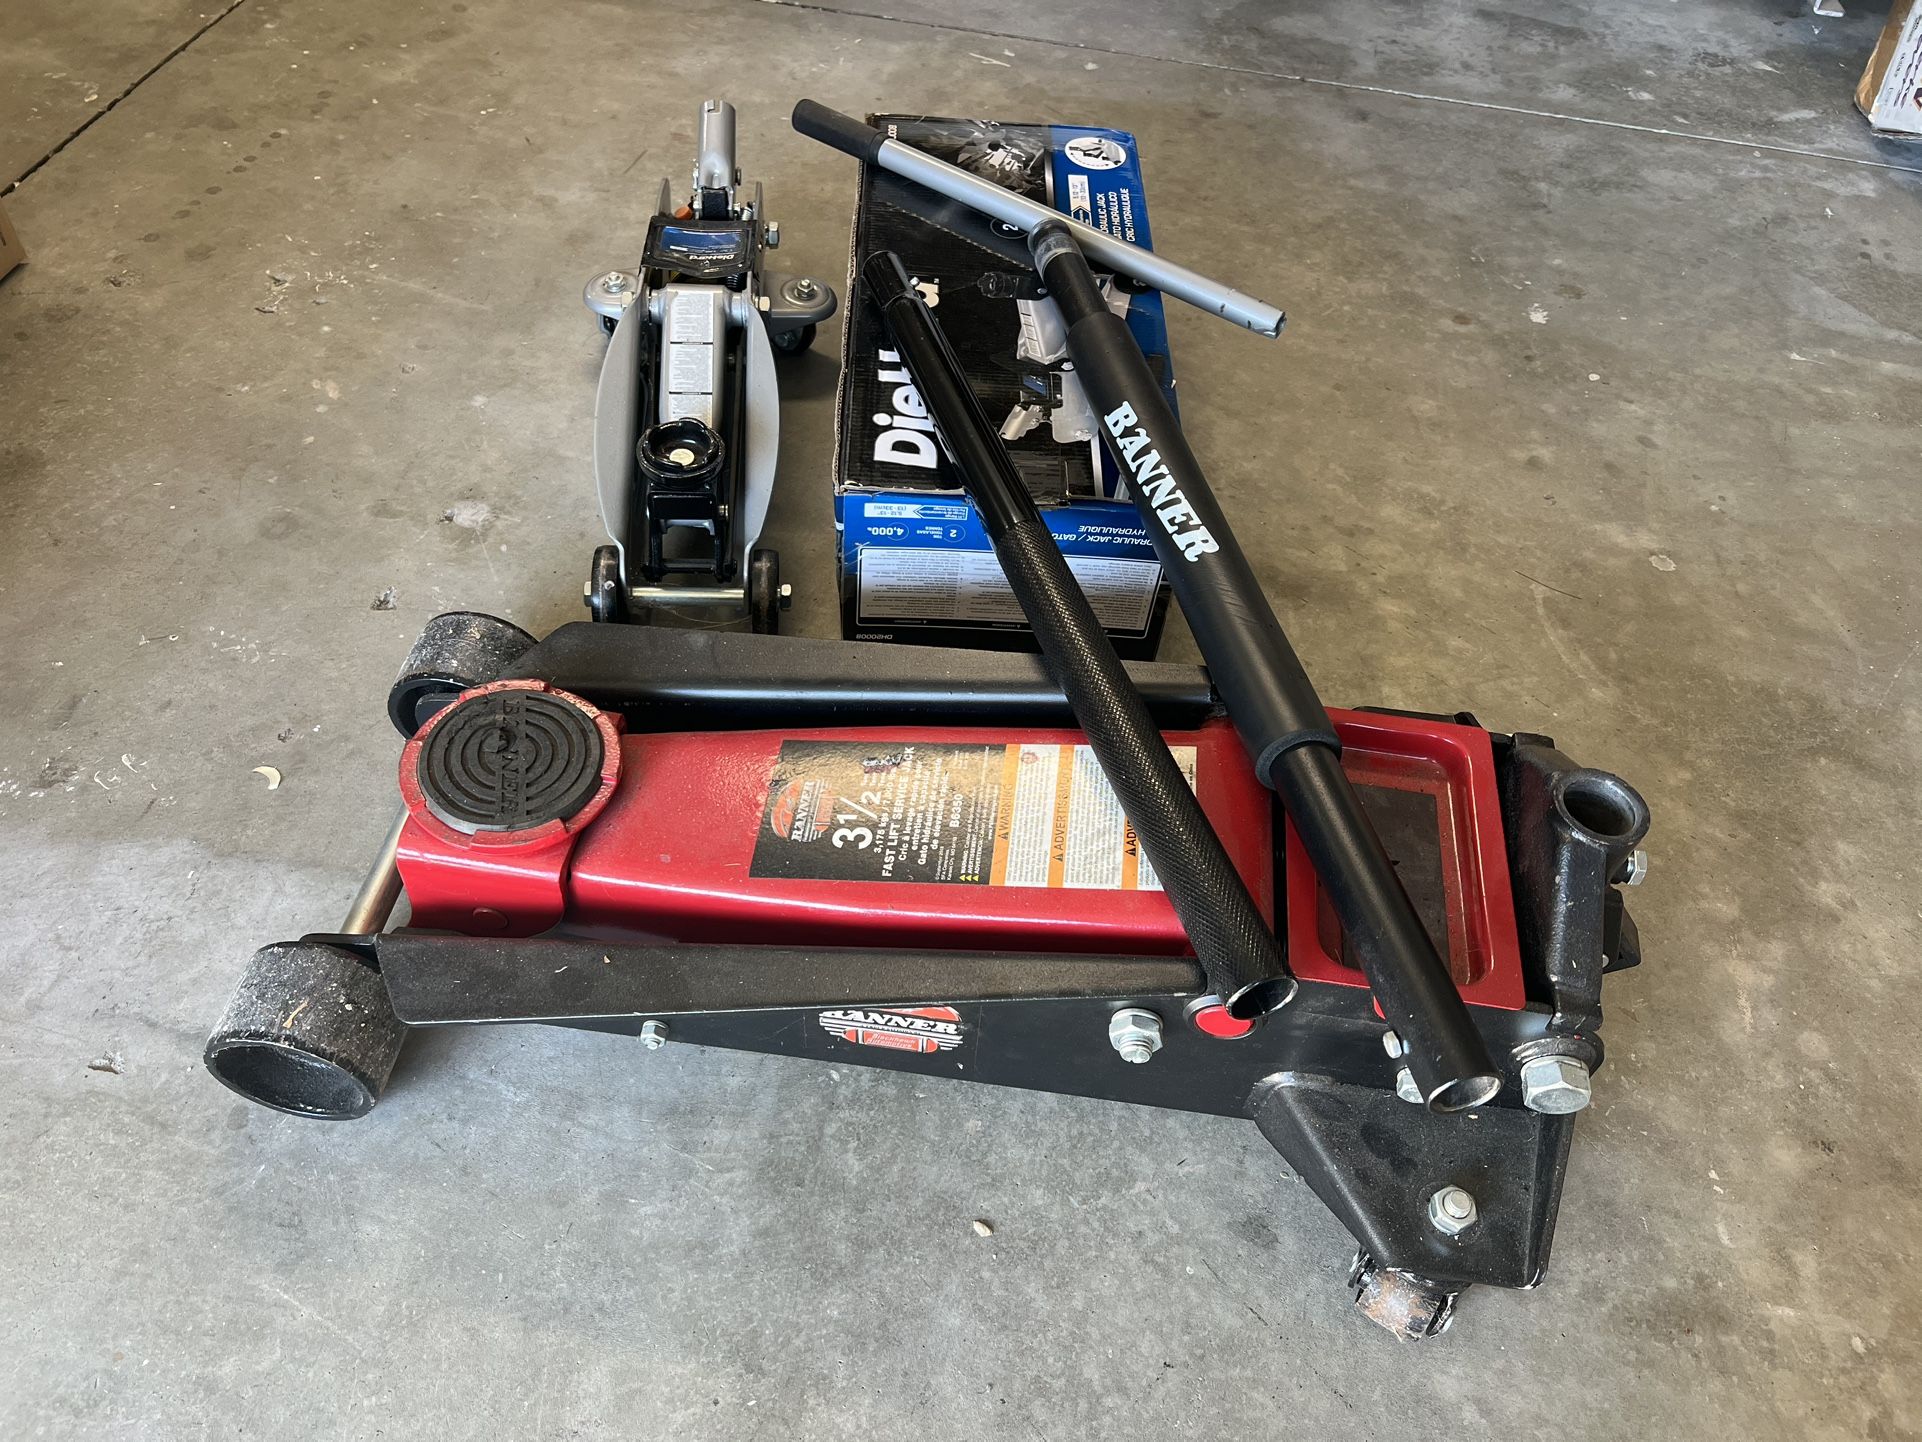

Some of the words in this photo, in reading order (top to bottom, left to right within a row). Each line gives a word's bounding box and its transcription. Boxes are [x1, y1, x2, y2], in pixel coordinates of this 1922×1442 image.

[1096, 193, 1105, 208] JACK
[1109, 192, 1120, 225] HIDRÁULICO
[1120, 188, 1134, 227] HYDRAULIQUE
[1098, 209, 1109, 234] DRAULIC
[1113, 226, 1122, 239] ATO
[1125, 228, 1135, 241] CRIC
[1105, 401, 1220, 562] BANNER
[950, 529, 957, 537] 2
[1077, 525, 1146, 536] HYDRAULIQUE
[1086, 535, 1112, 543] JACK
[900, 746, 914, 772] JACK
[892, 775, 909, 820] SERVICE
[999, 784, 1013, 832] WARNING
[791, 781, 814, 841] BANNER
[902, 808, 915, 833] levage
[921, 803, 937, 842] hidráulico
[932, 799, 945, 837] elevación
[949, 794, 963, 828] B6350
[887, 823, 900, 845] LIFT
[911, 813, 924, 850] entretien
[899, 843, 909, 860] Cric
[918, 845, 928, 865] Gato
[931, 840, 939, 849] de
[882, 849, 895, 876] FAST
